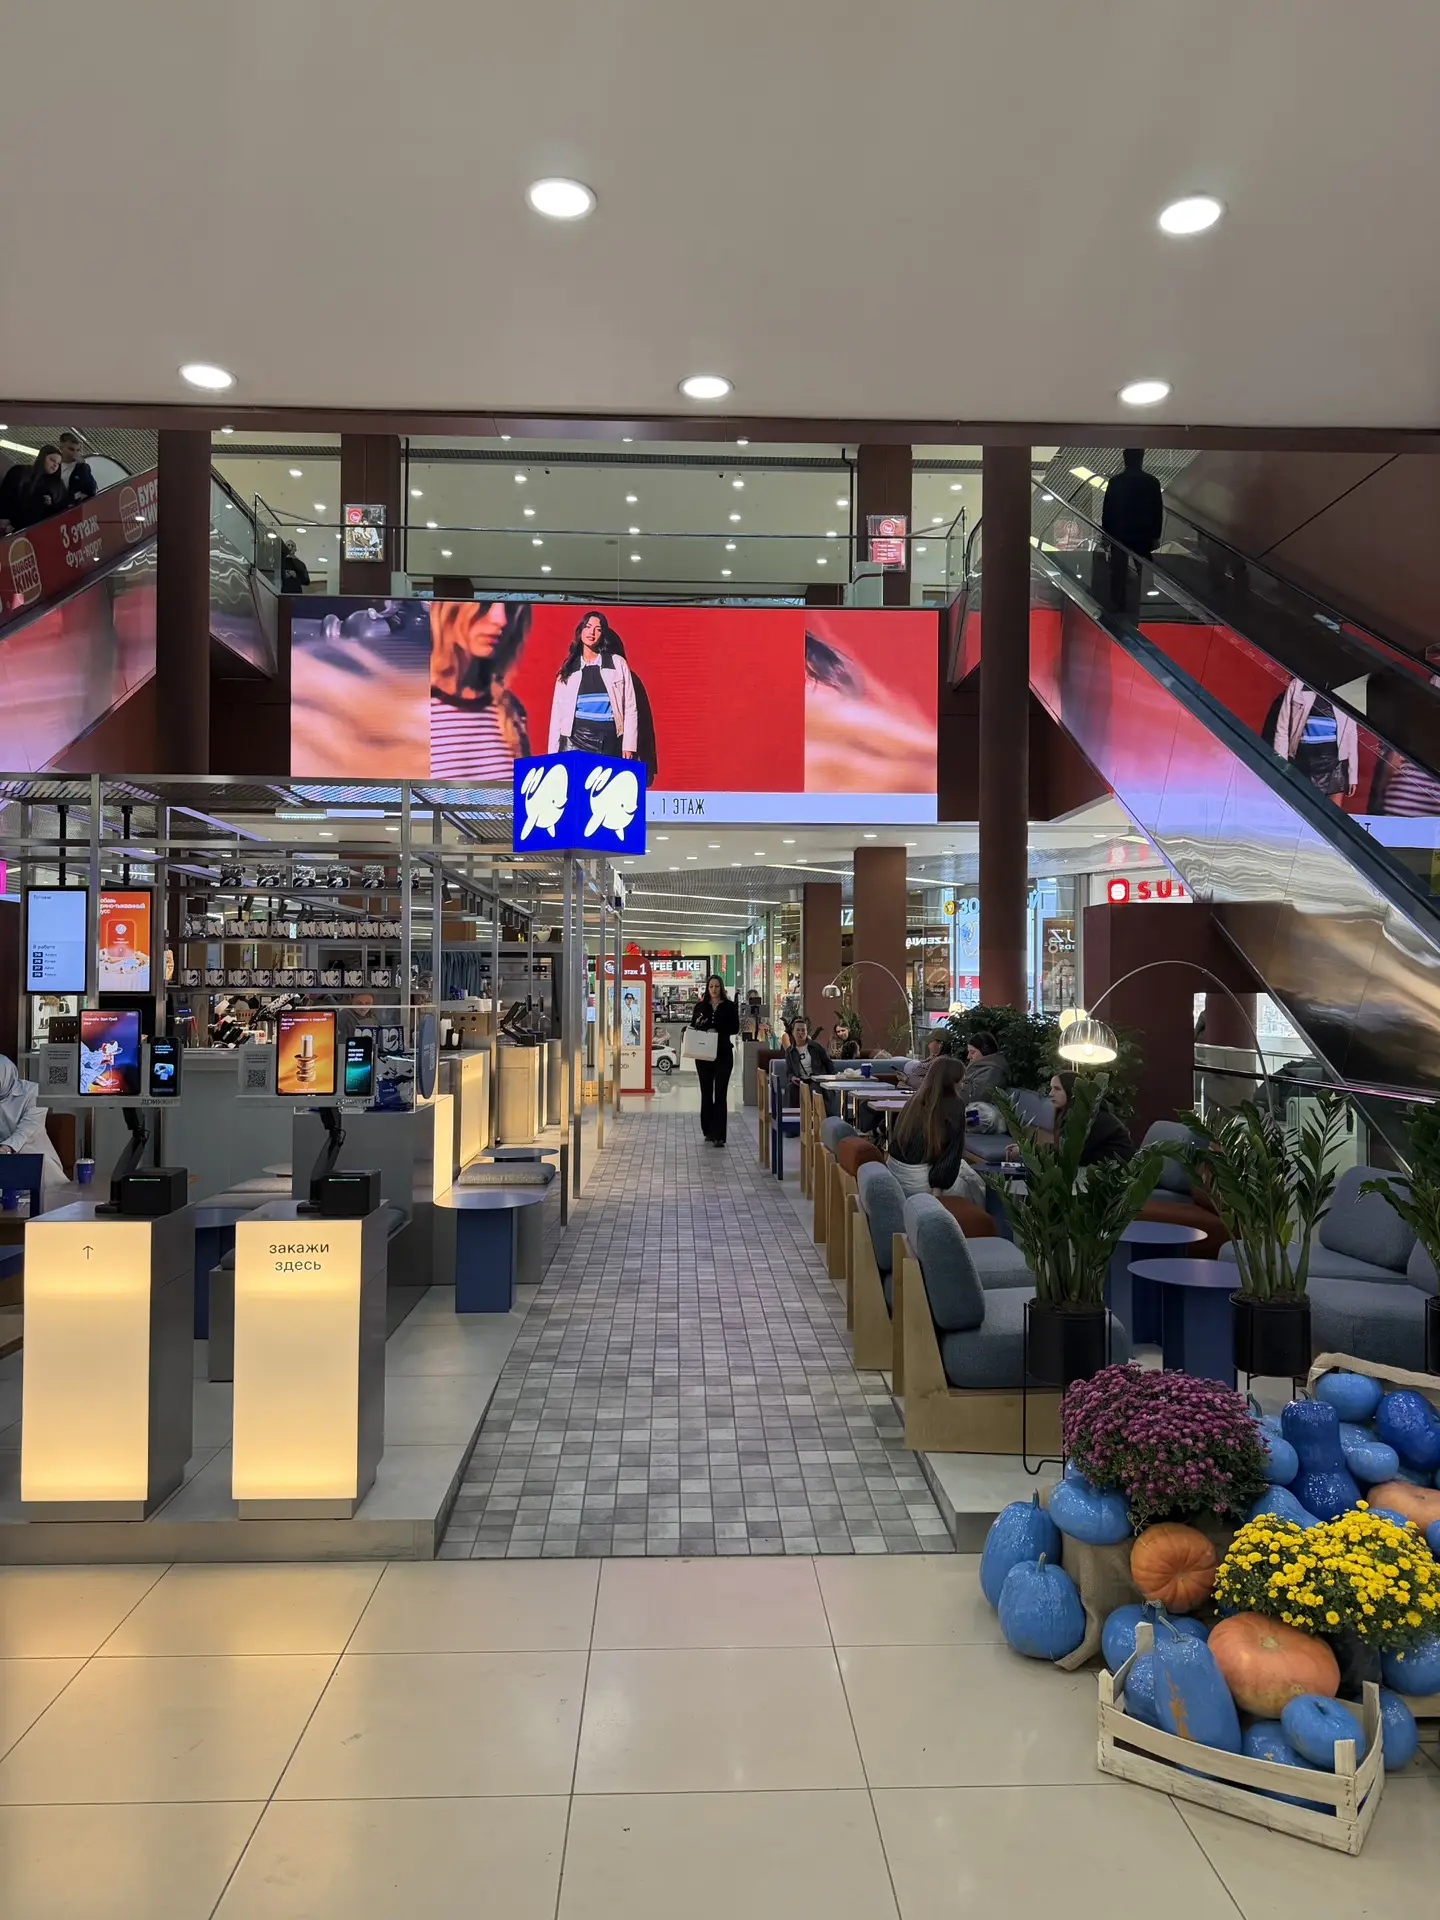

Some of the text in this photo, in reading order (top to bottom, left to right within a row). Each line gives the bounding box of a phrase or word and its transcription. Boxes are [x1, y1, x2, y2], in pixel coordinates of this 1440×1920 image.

[60, 514, 100, 548] 3 этаж
[11, 554, 36, 576] BURGER
[14, 567, 40, 594] KING
[662, 798, 705, 815] 1 ЭТАЖ
[639, 963, 647, 975] 1
[676, 961, 700, 971] LIKE
[269, 1243, 330, 1254] закажи
[275, 1260, 322, 1273] здесь
